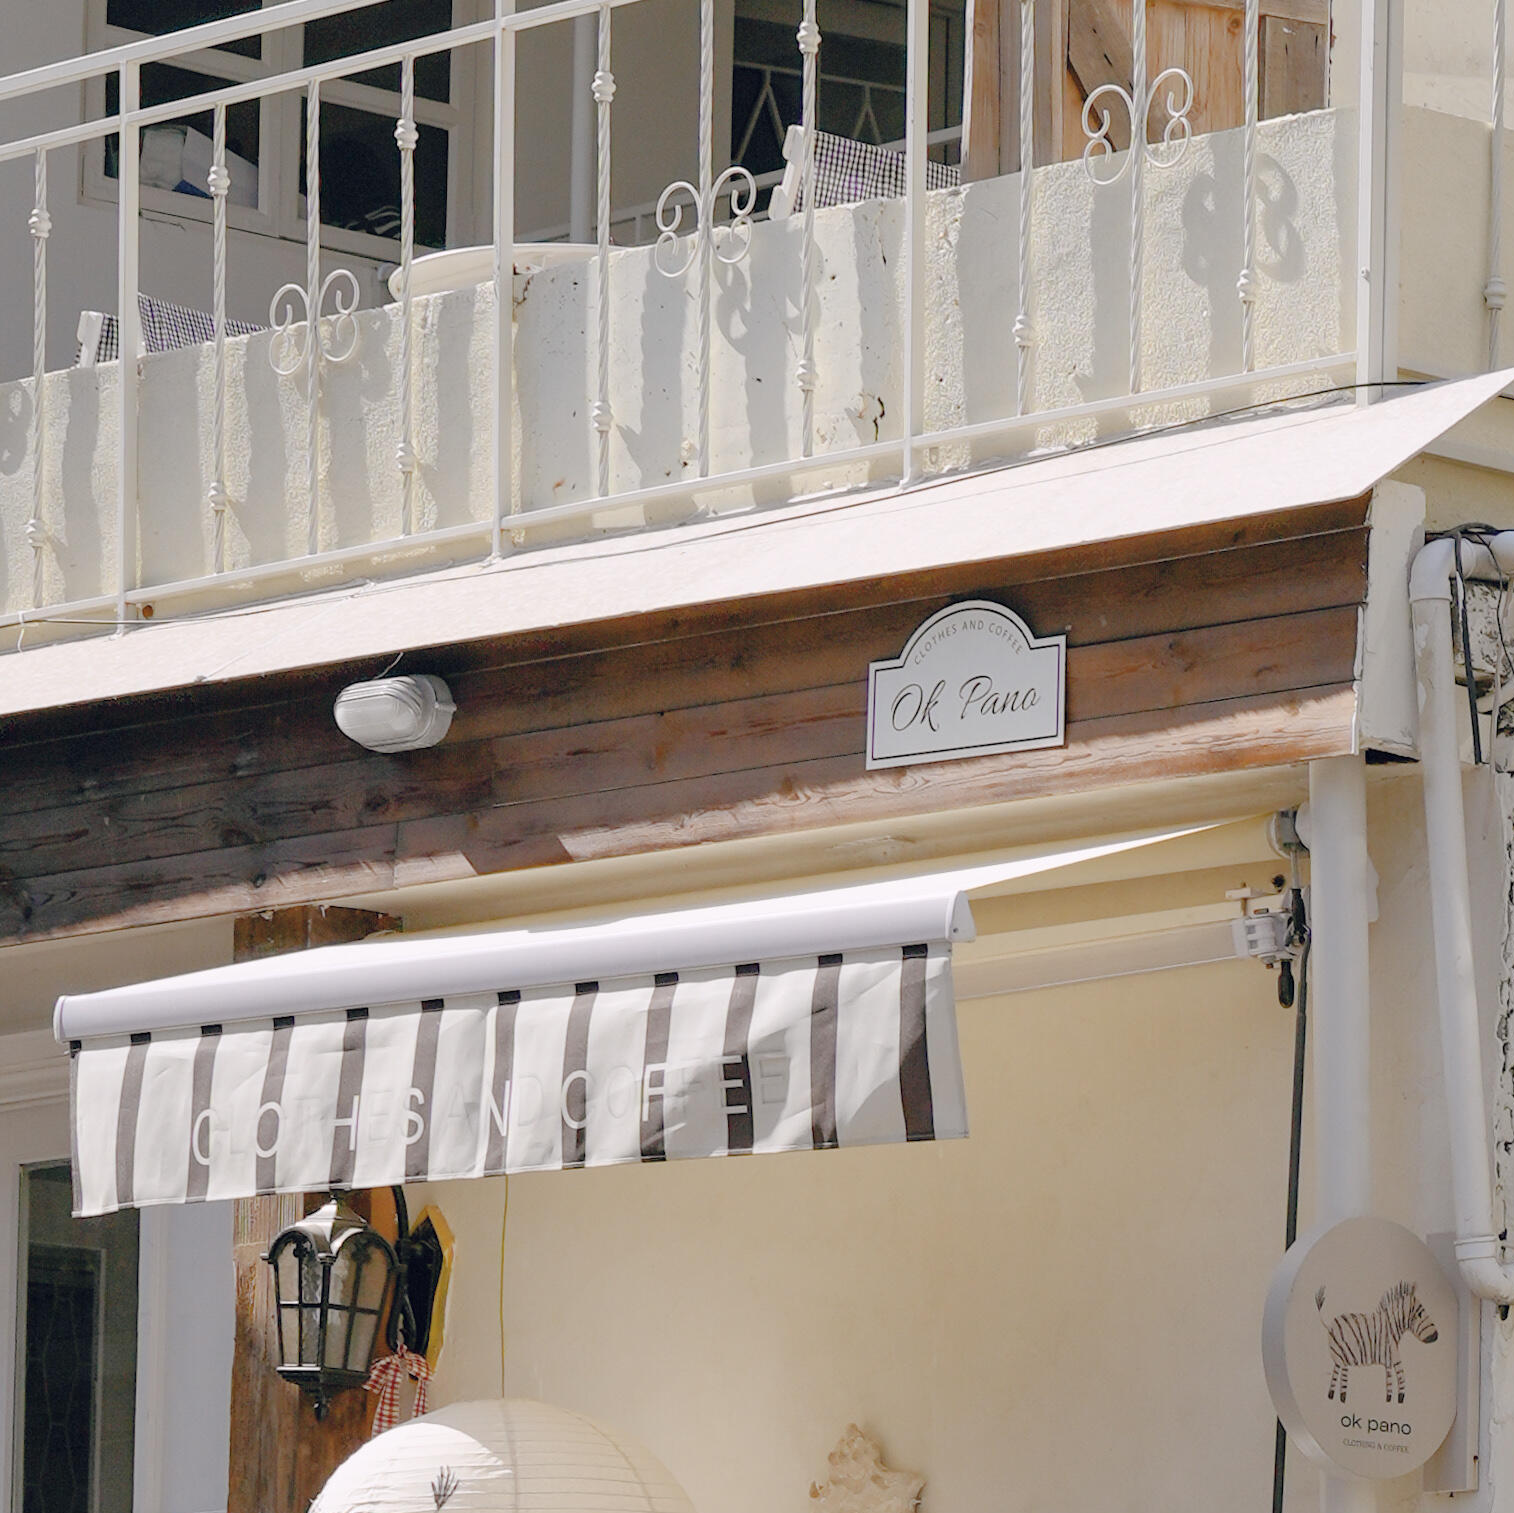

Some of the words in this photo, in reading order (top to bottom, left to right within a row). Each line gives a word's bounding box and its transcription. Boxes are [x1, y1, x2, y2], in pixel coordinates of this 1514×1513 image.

[914, 624, 957, 665] CLOTHES
[962, 620, 984, 631] AND
[989, 622, 1024, 655] COFFEE
[891, 679, 946, 732] Ok
[959, 675, 1041, 720] Pano
[191, 1087, 426, 1166] CLOTHES
[446, 1074, 547, 1140] AND
[560, 1055, 791, 1130] COFFEE
[1340, 1413, 1363, 1429] ok
[1367, 1418, 1412, 1435] pano
